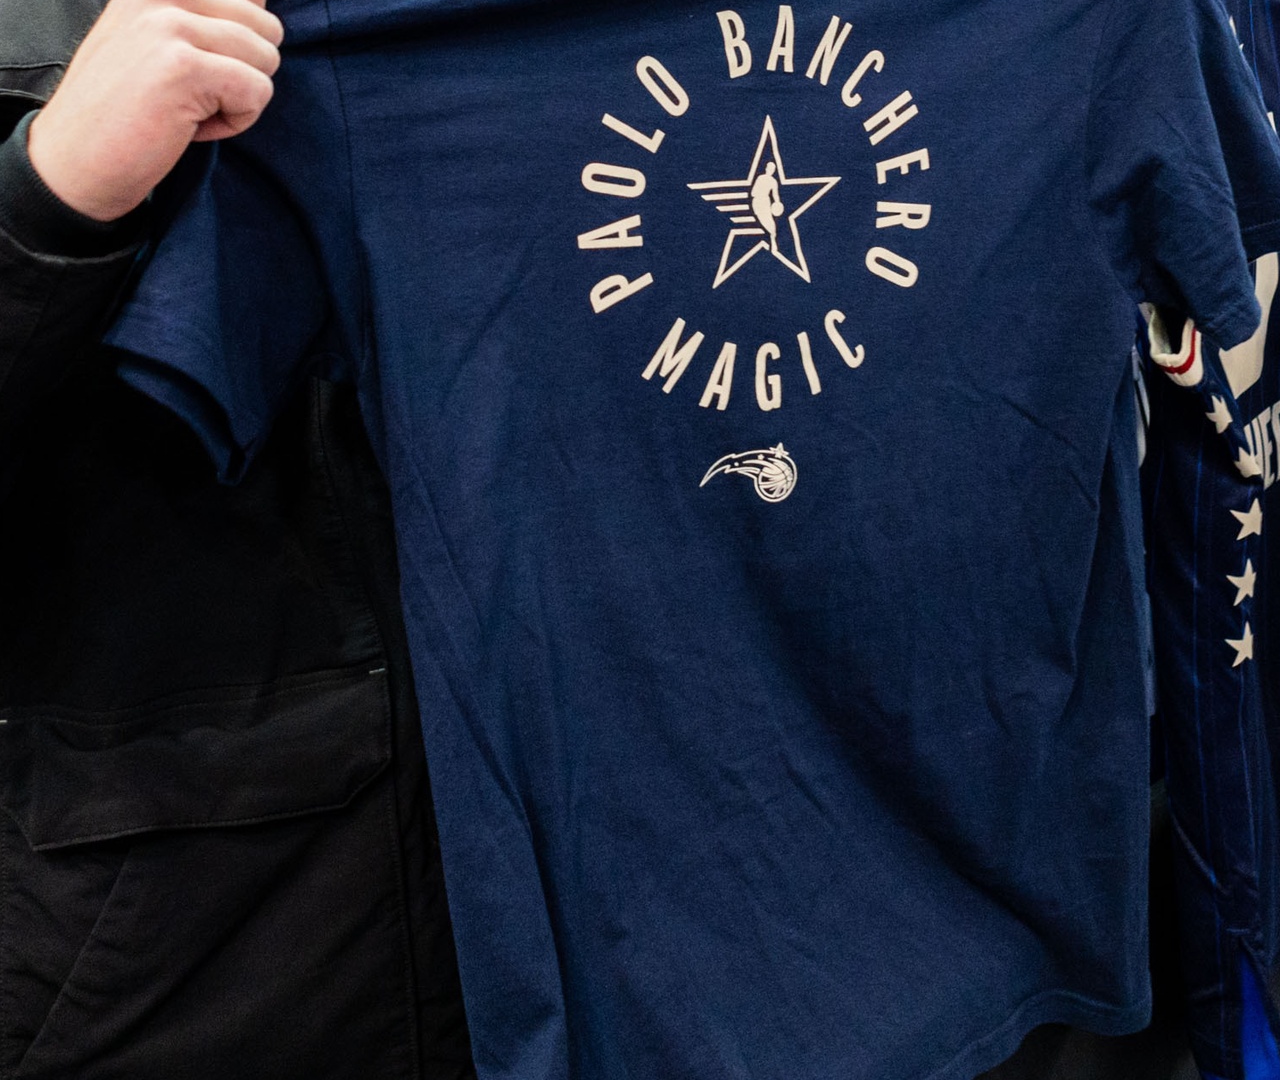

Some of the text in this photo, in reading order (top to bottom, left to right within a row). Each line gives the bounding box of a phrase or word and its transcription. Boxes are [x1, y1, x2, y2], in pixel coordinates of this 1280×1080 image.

[577, 4, 932, 314] PAOLO BANCHERO
[641, 309, 865, 411] MAGIC
